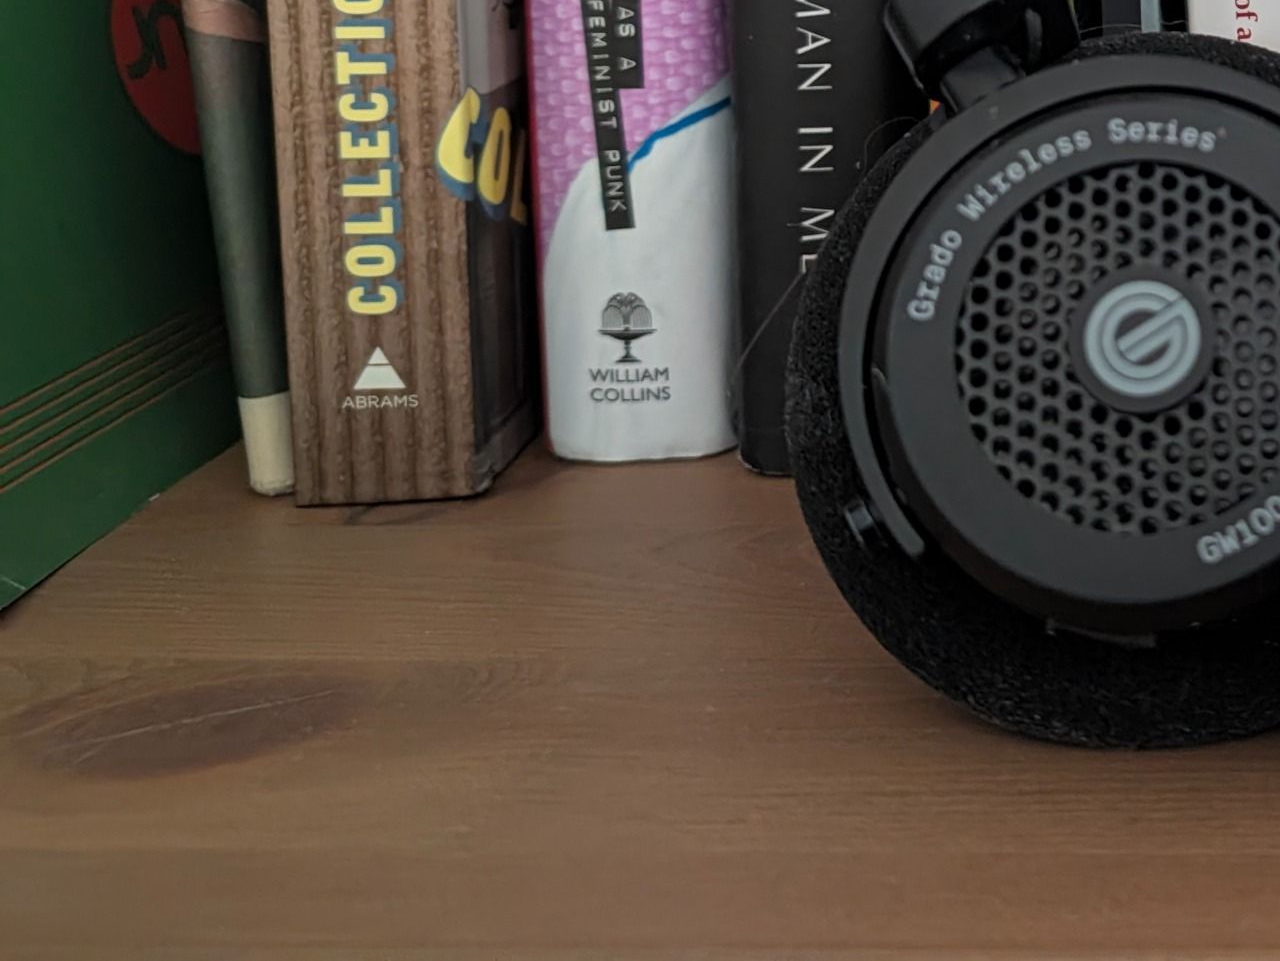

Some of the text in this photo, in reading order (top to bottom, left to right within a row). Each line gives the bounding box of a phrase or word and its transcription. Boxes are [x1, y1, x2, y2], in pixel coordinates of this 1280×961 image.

[617, 6, 636, 37] AS
[619, 56, 637, 71] A
[587, 0, 627, 213] FEMINIST PUNK
[797, 126, 834, 174] IN
[907, 117, 1217, 321] Grado Wireless Series
[589, 367, 671, 385] WILLIAM
[341, 393, 420, 410] ABRAMS
[589, 386, 672, 404] COLLINS
